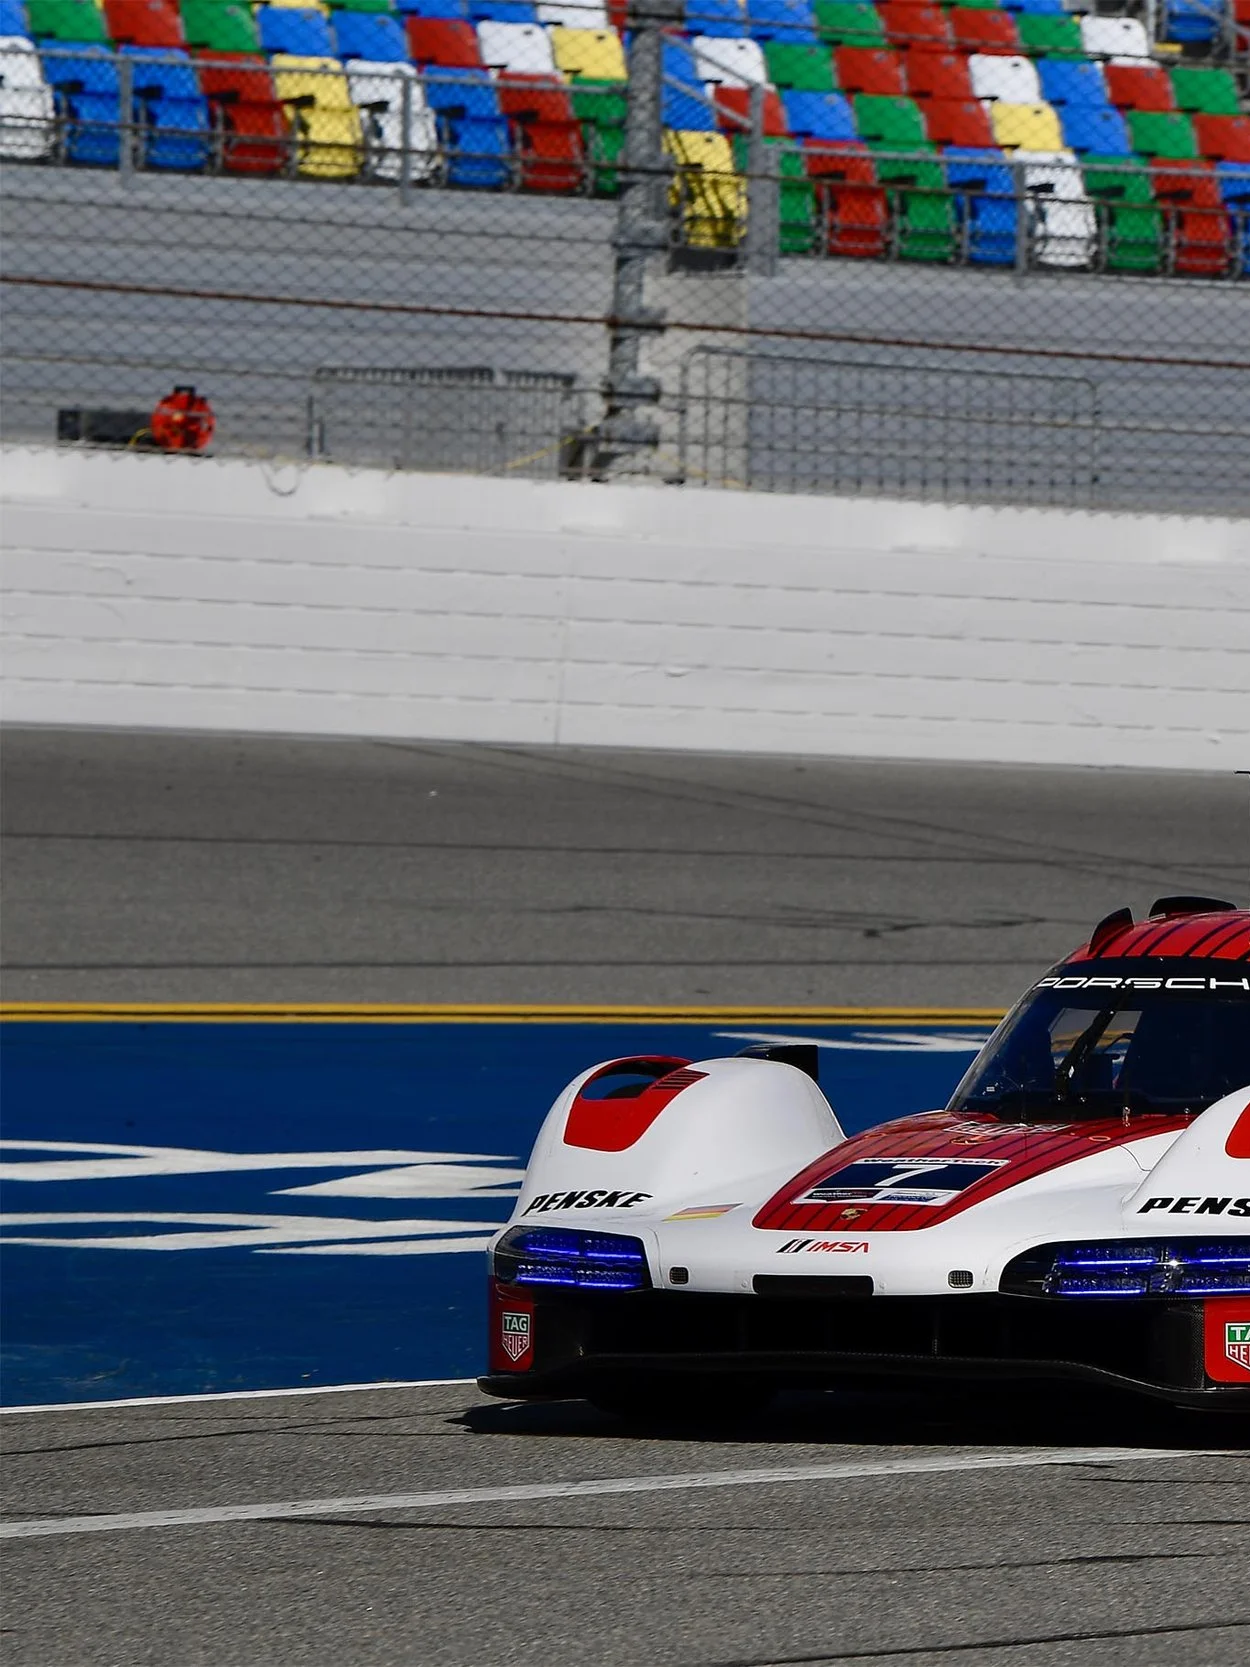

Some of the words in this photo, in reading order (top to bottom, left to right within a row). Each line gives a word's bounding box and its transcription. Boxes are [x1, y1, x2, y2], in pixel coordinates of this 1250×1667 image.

[874, 1164, 949, 1187] 7
[520, 1189, 655, 1217] PENSKE
[504, 1316, 528, 1332] TAG
[502, 1334, 529, 1358] HEUER
